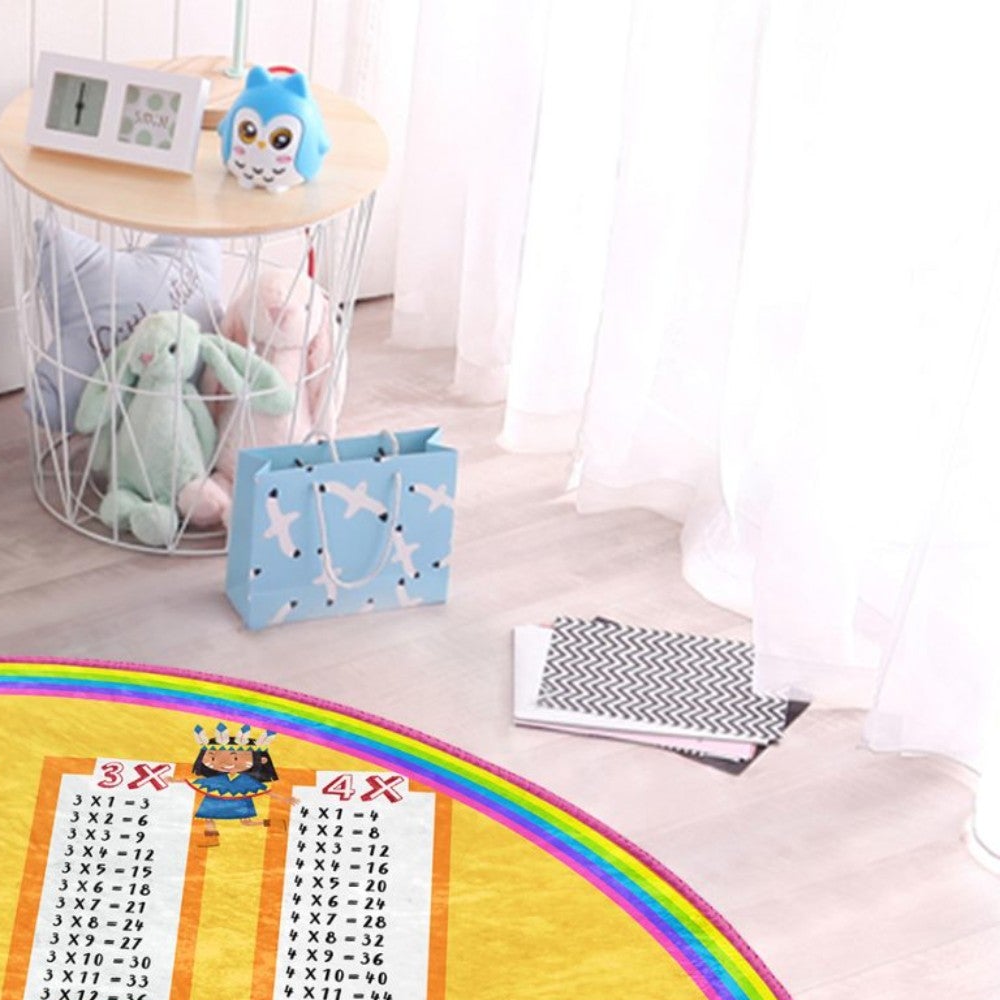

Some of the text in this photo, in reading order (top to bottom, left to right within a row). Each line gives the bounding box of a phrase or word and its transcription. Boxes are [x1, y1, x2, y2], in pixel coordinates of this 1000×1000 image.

[64, 845, 74, 856] 3
[134, 849, 154, 861] 12
[294, 875, 303, 887] 4
[365, 879, 387, 893] 20
[40, 988, 50, 1000] 3
[284, 985, 293, 998] 4
